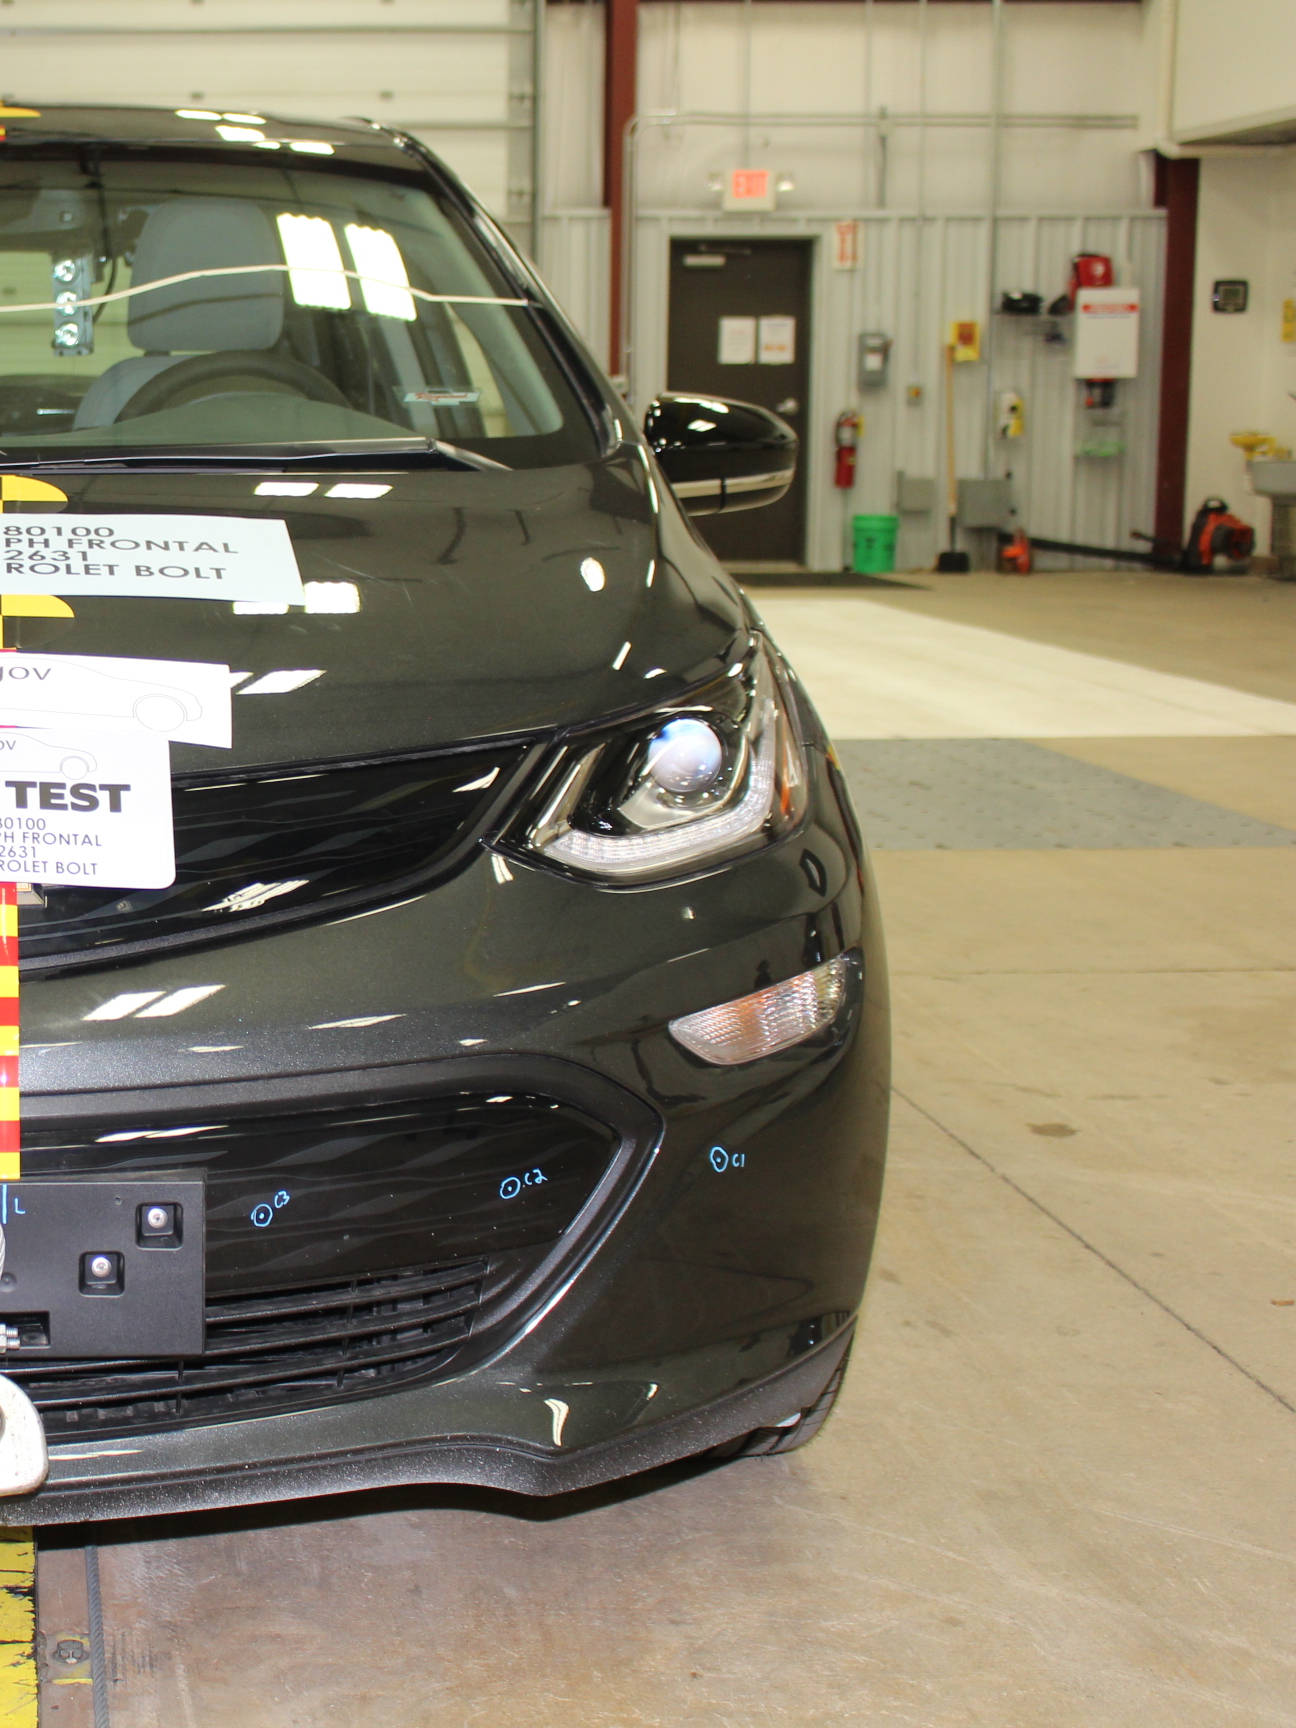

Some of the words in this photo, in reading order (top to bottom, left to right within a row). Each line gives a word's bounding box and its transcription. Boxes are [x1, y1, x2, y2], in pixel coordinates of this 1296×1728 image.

[68, 538, 238, 553] FRONTAL
[134, 565, 226, 580] BOLT
[5, 781, 131, 813] TEST
[23, 832, 102, 847] FRONTAL
[56, 861, 98, 875] BOLT
